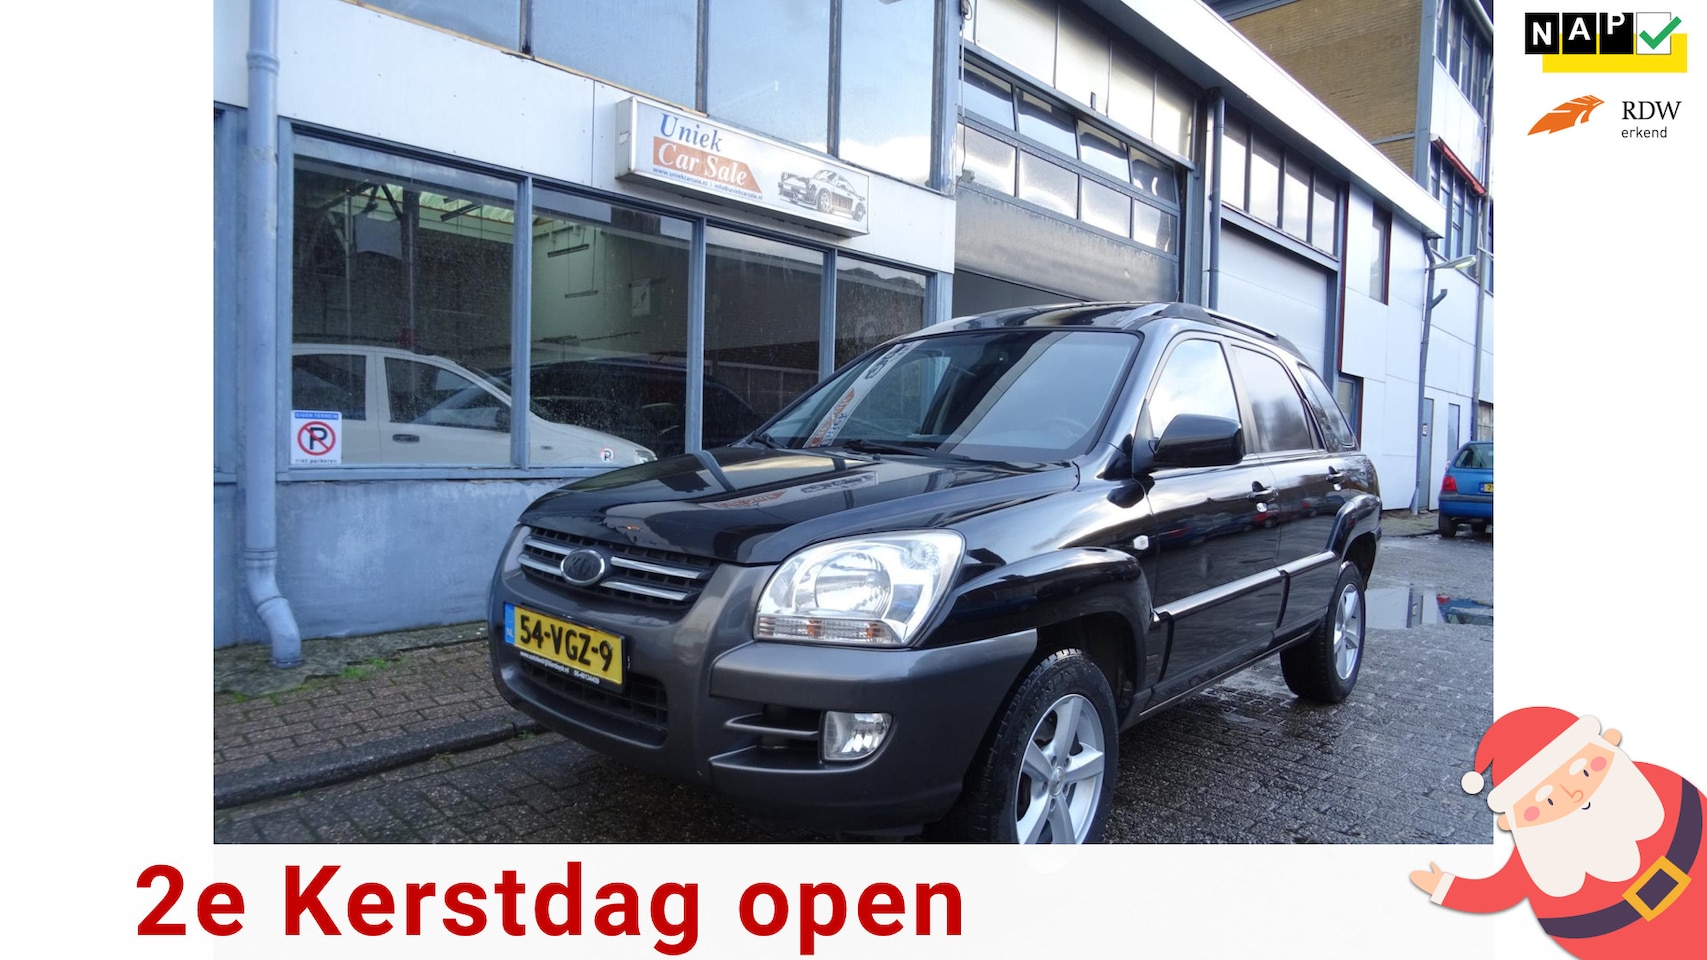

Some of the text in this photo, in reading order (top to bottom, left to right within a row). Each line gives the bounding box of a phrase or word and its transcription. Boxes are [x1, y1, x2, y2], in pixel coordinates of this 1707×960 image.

[660, 113, 723, 152] Uniek
[652, 167, 763, 200] www.uniekcarsale.nl info@uniekcarsale.nl
[658, 142, 748, 186] Car Sale
[520, 614, 613, 672] 54-VGZ-9
